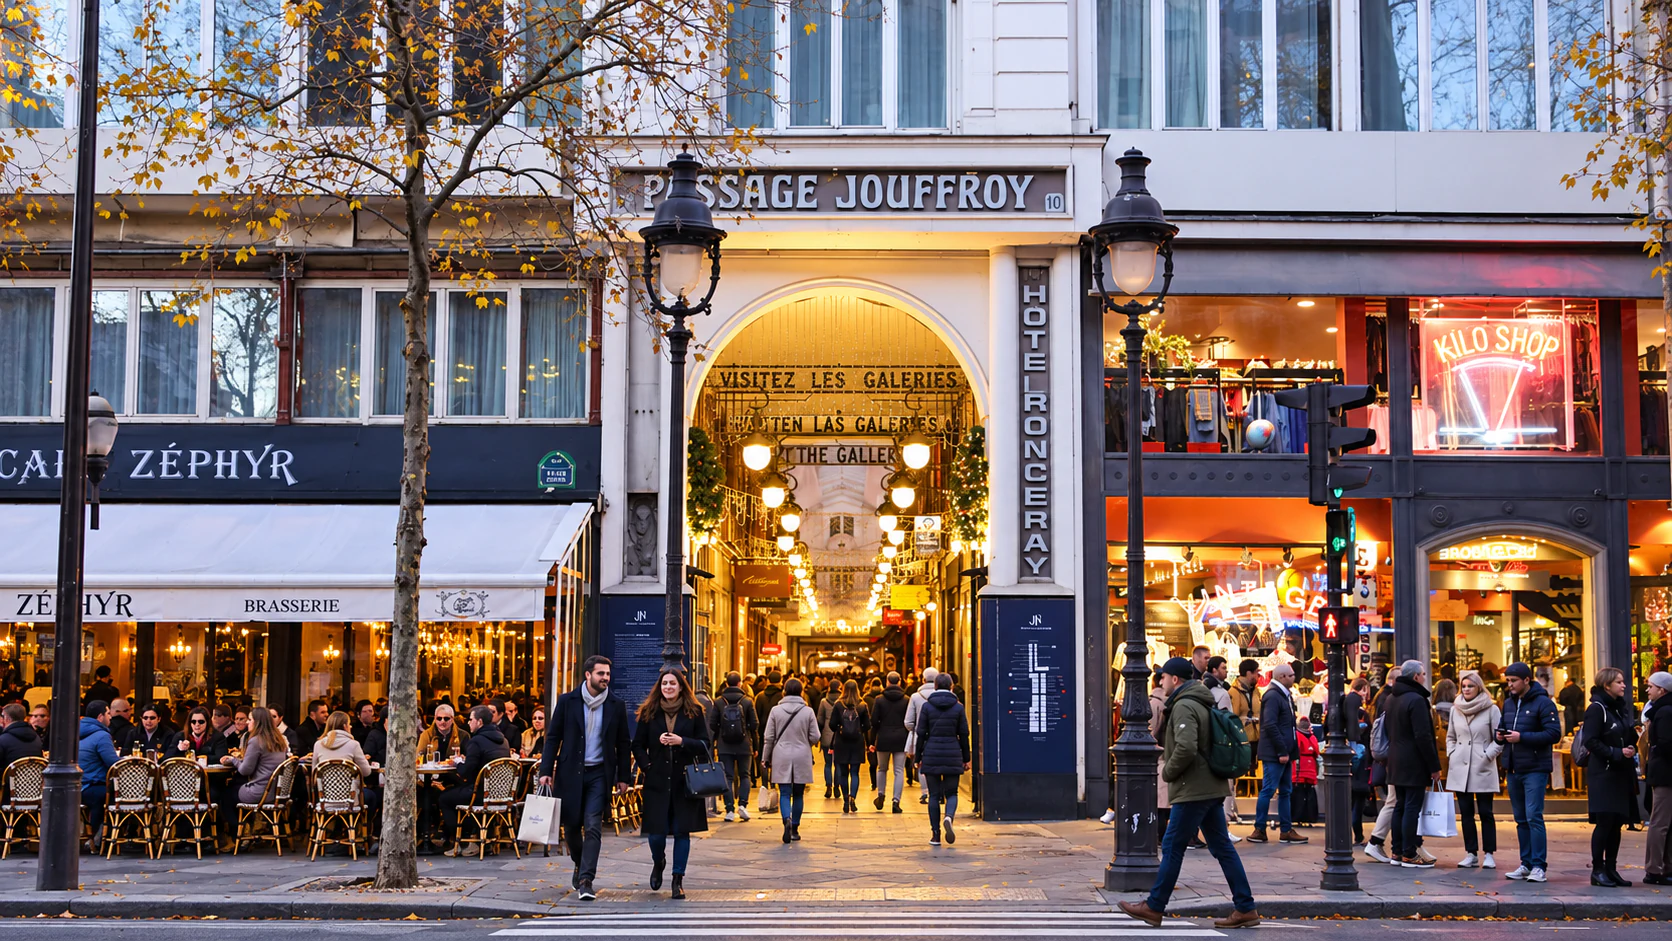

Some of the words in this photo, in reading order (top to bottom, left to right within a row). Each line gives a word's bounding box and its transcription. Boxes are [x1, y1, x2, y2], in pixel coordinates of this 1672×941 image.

[643, 174, 818, 209] PSSAGE
[835, 174, 1034, 209] JOUFFROY
[1046, 195, 1061, 210] 10
[1433, 326, 1489, 363] KILO
[1495, 325, 1560, 360] SHOP
[720, 371, 796, 389] VISITEZ
[811, 371, 846, 389] LES
[863, 371, 958, 389] GALERIES
[814, 416, 845, 432] LAS
[0, 449, 63, 485] CA
[130, 442, 298, 486] ZÉPHYR
[800, 447, 828, 463] THE
[1024, 393, 1048, 575] RONCERAY
[16, 590, 134, 617] ZÉHYR
[244, 599, 340, 613] BRASSERIE
